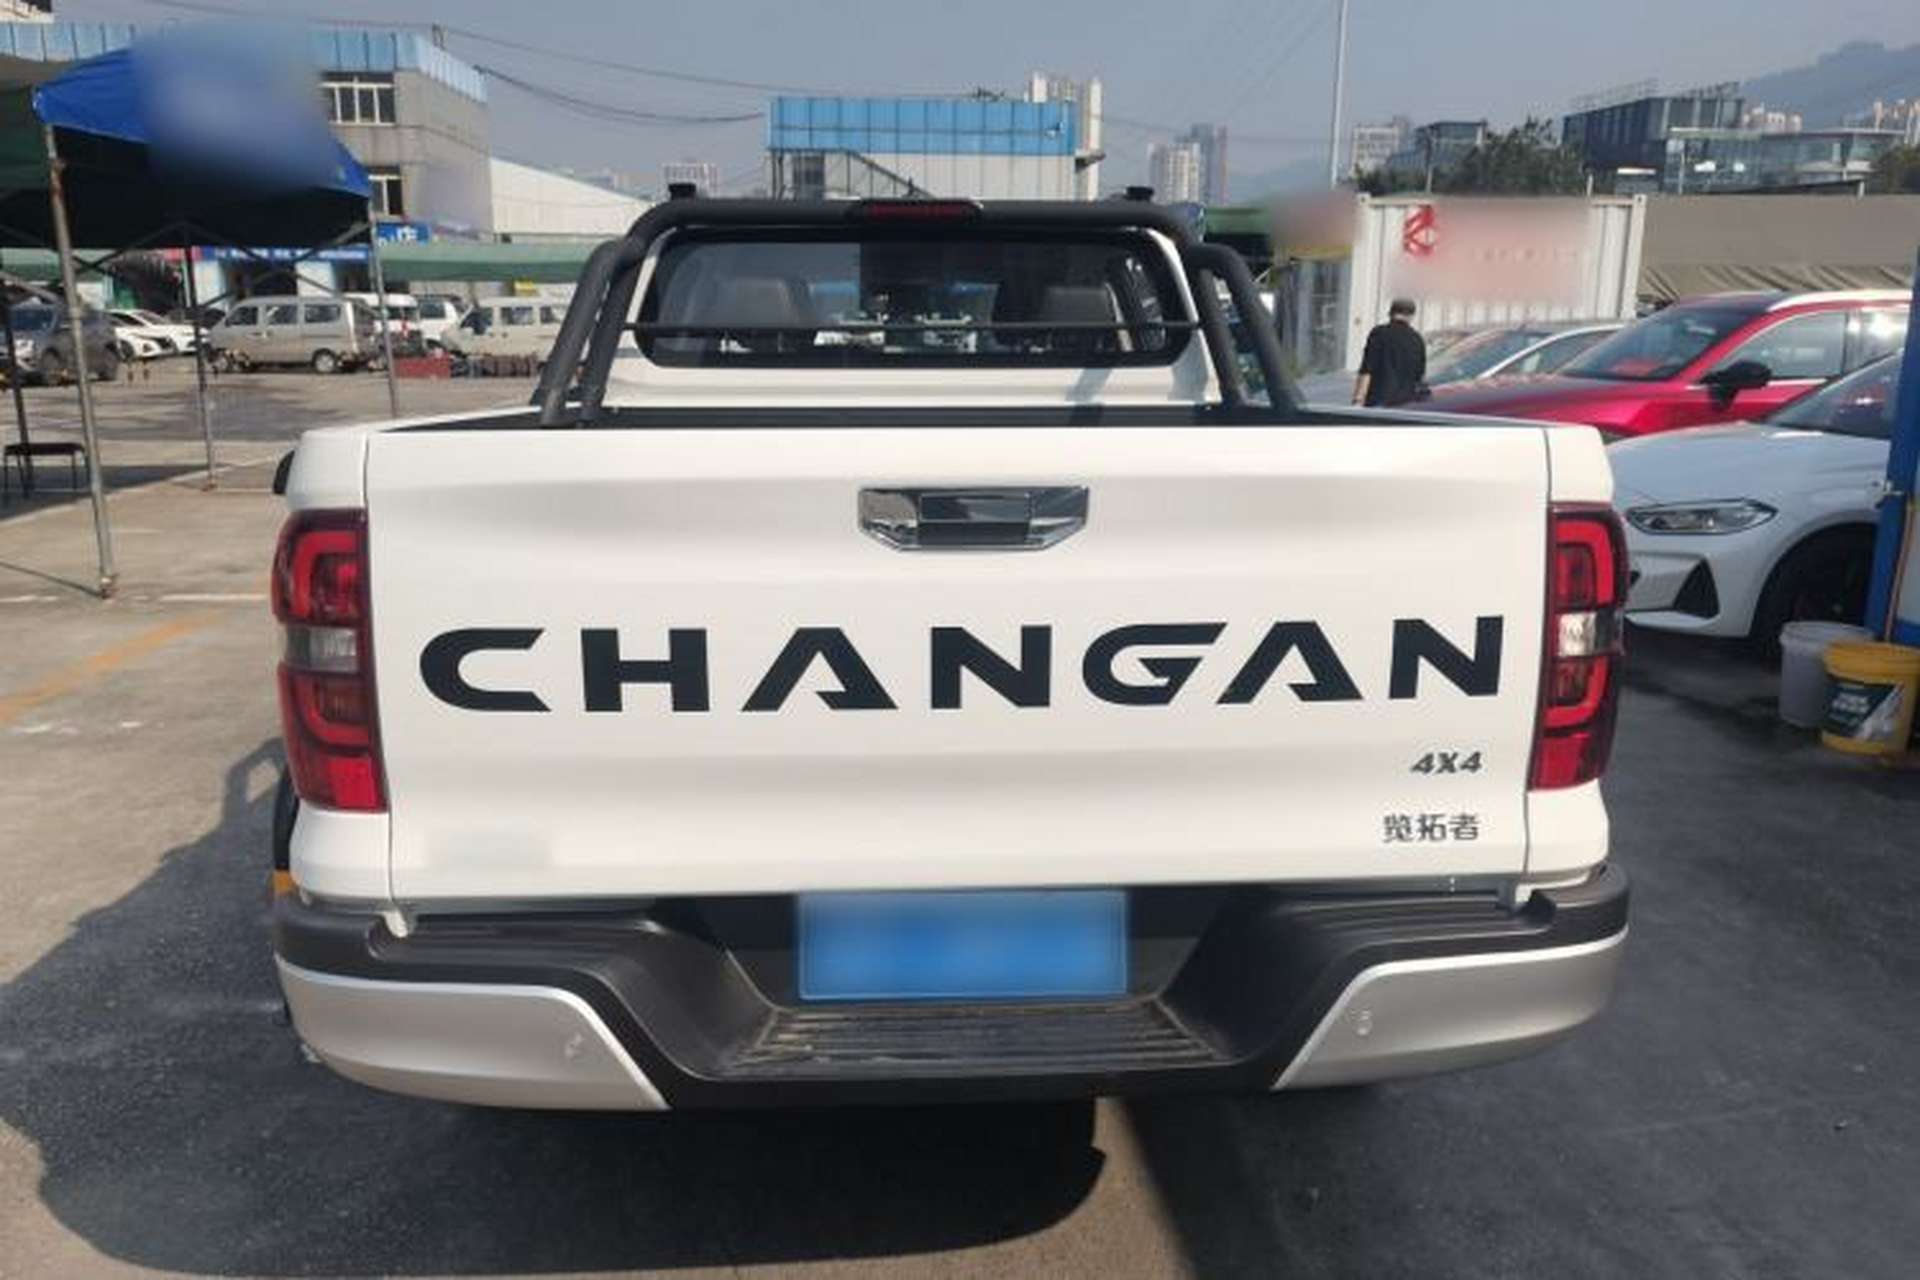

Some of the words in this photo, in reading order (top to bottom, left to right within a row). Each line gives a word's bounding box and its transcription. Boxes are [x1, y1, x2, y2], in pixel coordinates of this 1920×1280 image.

[420, 615, 1503, 712] CHANGAN
[1383, 813, 1479, 843] 览拓者
